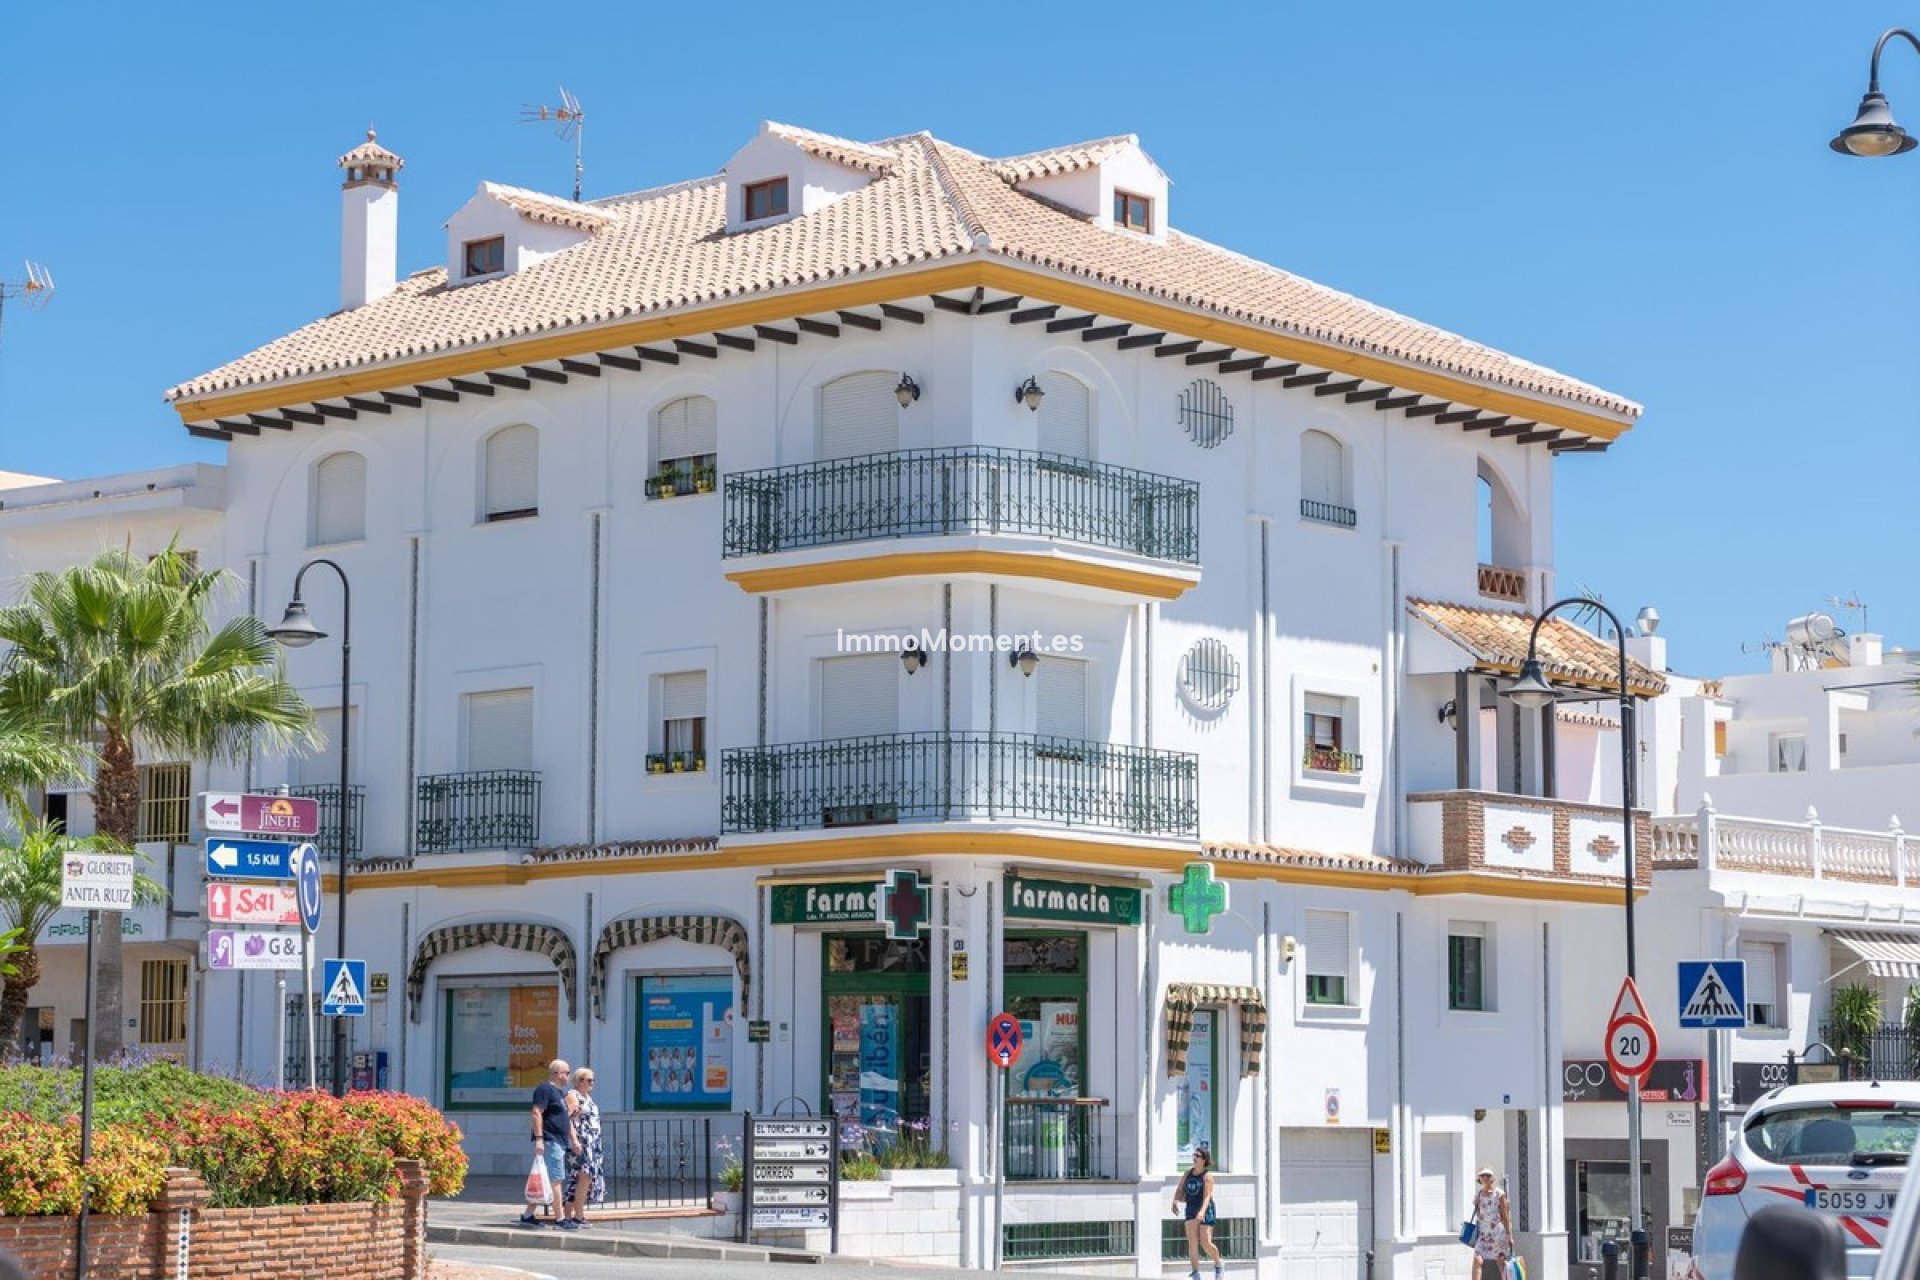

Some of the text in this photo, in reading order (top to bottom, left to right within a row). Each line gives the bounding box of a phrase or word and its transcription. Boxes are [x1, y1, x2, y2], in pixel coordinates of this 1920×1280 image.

[262, 854, 280, 866] KM
[87, 861, 132, 876] GLORIETA
[66, 887, 130, 903] ANITA RUIZ
[1620, 1036, 1641, 1056] 20
[756, 1124, 765, 1134] EL
[755, 1166, 794, 1179] CORREOS
[1818, 1192, 1866, 1209] 5059
